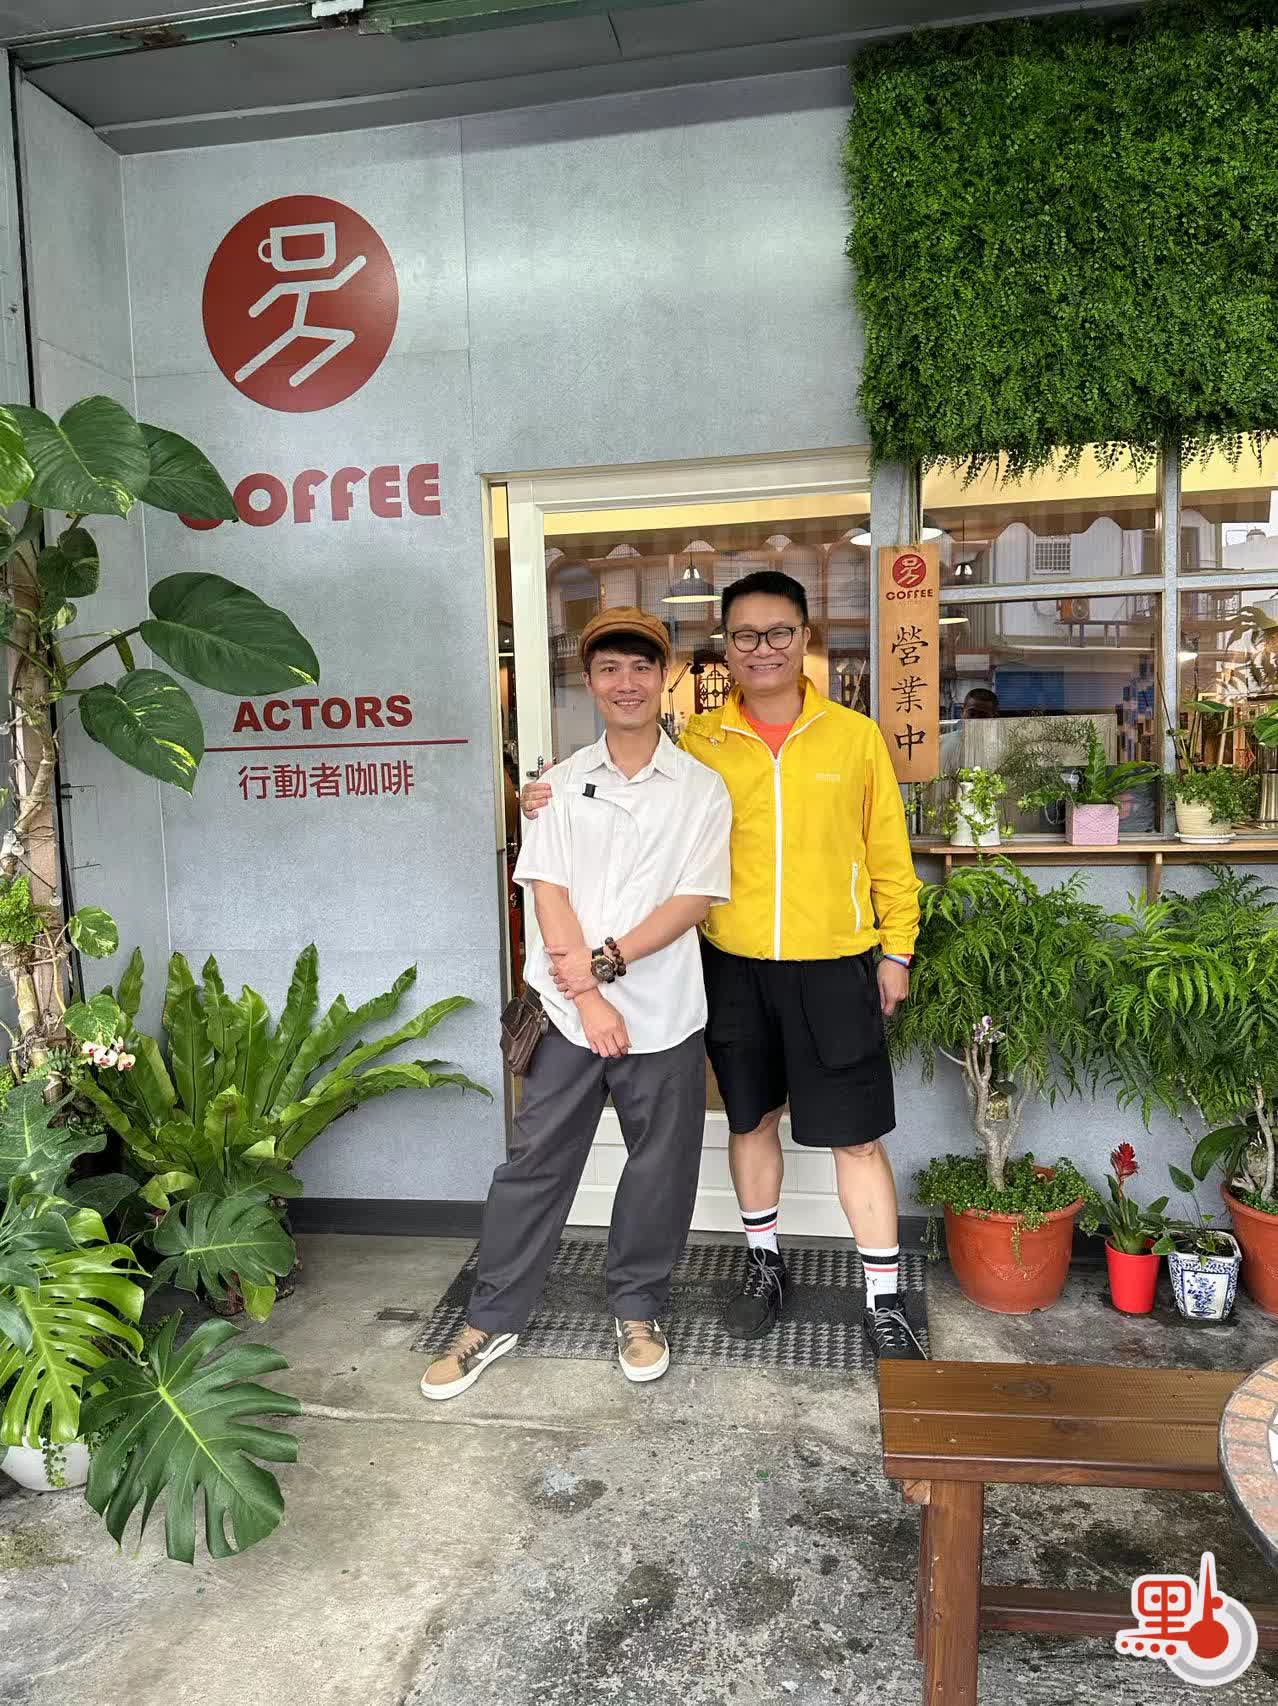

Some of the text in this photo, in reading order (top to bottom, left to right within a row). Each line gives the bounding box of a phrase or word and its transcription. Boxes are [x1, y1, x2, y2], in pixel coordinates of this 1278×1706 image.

[177, 463, 441, 531] OFFEE
[886, 589, 933, 600] COFFEE
[232, 694, 413, 733] ACTORS
[891, 625, 928, 761] 營業中
[238, 760, 415, 801] 行動者咖啡
